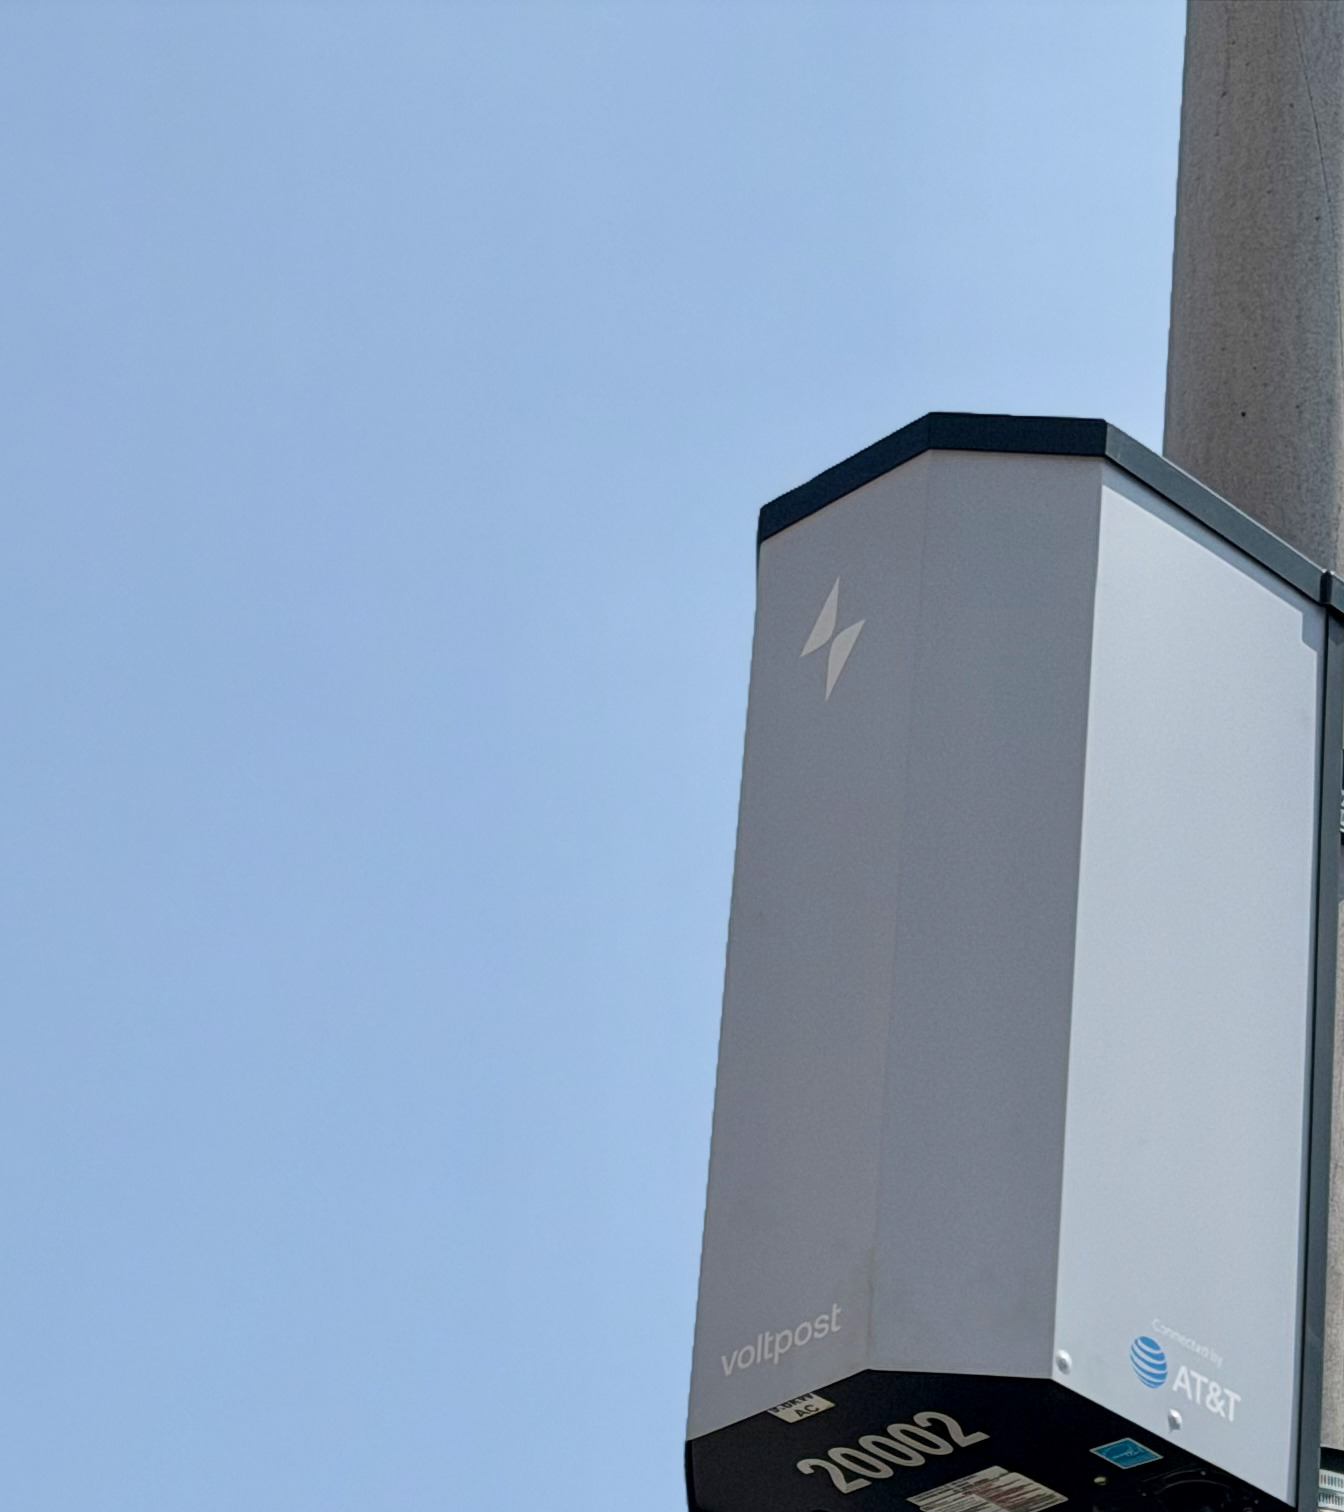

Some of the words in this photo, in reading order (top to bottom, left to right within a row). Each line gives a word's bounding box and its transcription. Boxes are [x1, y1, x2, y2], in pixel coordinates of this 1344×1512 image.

[721, 1303, 841, 1376] voltpost
[794, 1404, 820, 1417] AC
[1172, 1365, 1241, 1422] AT&T
[796, 1411, 991, 1494] 20002
